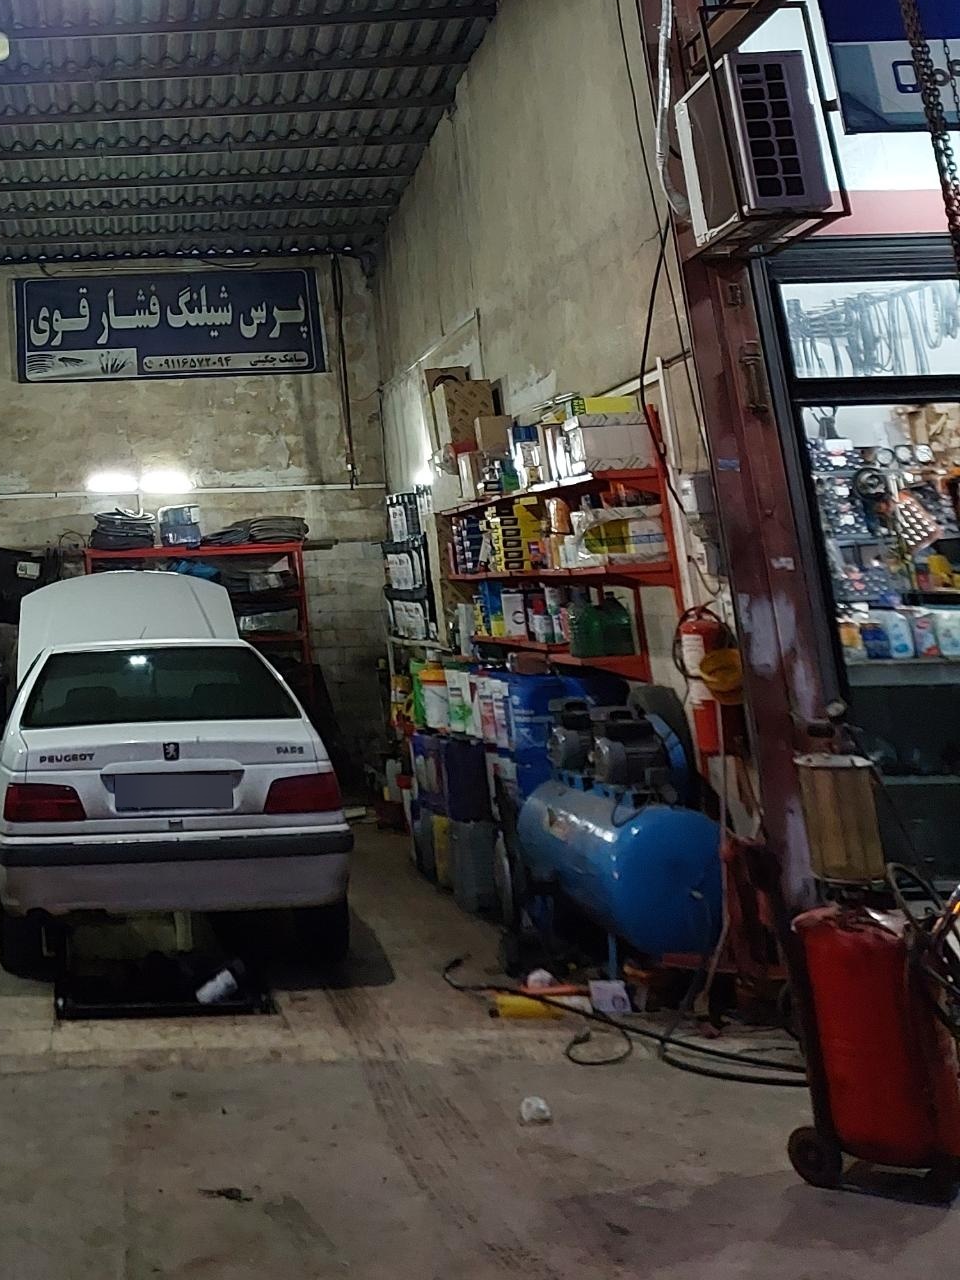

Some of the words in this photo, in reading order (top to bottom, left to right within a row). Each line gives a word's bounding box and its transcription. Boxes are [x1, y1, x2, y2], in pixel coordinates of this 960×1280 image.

[29, 287, 89, 347] قوی
[96, 284, 160, 345] فشار
[166, 284, 233, 338] شیلنگ
[240, 293, 308, 339] پرس
[39, 752, 95, 764] PEUGEOT
